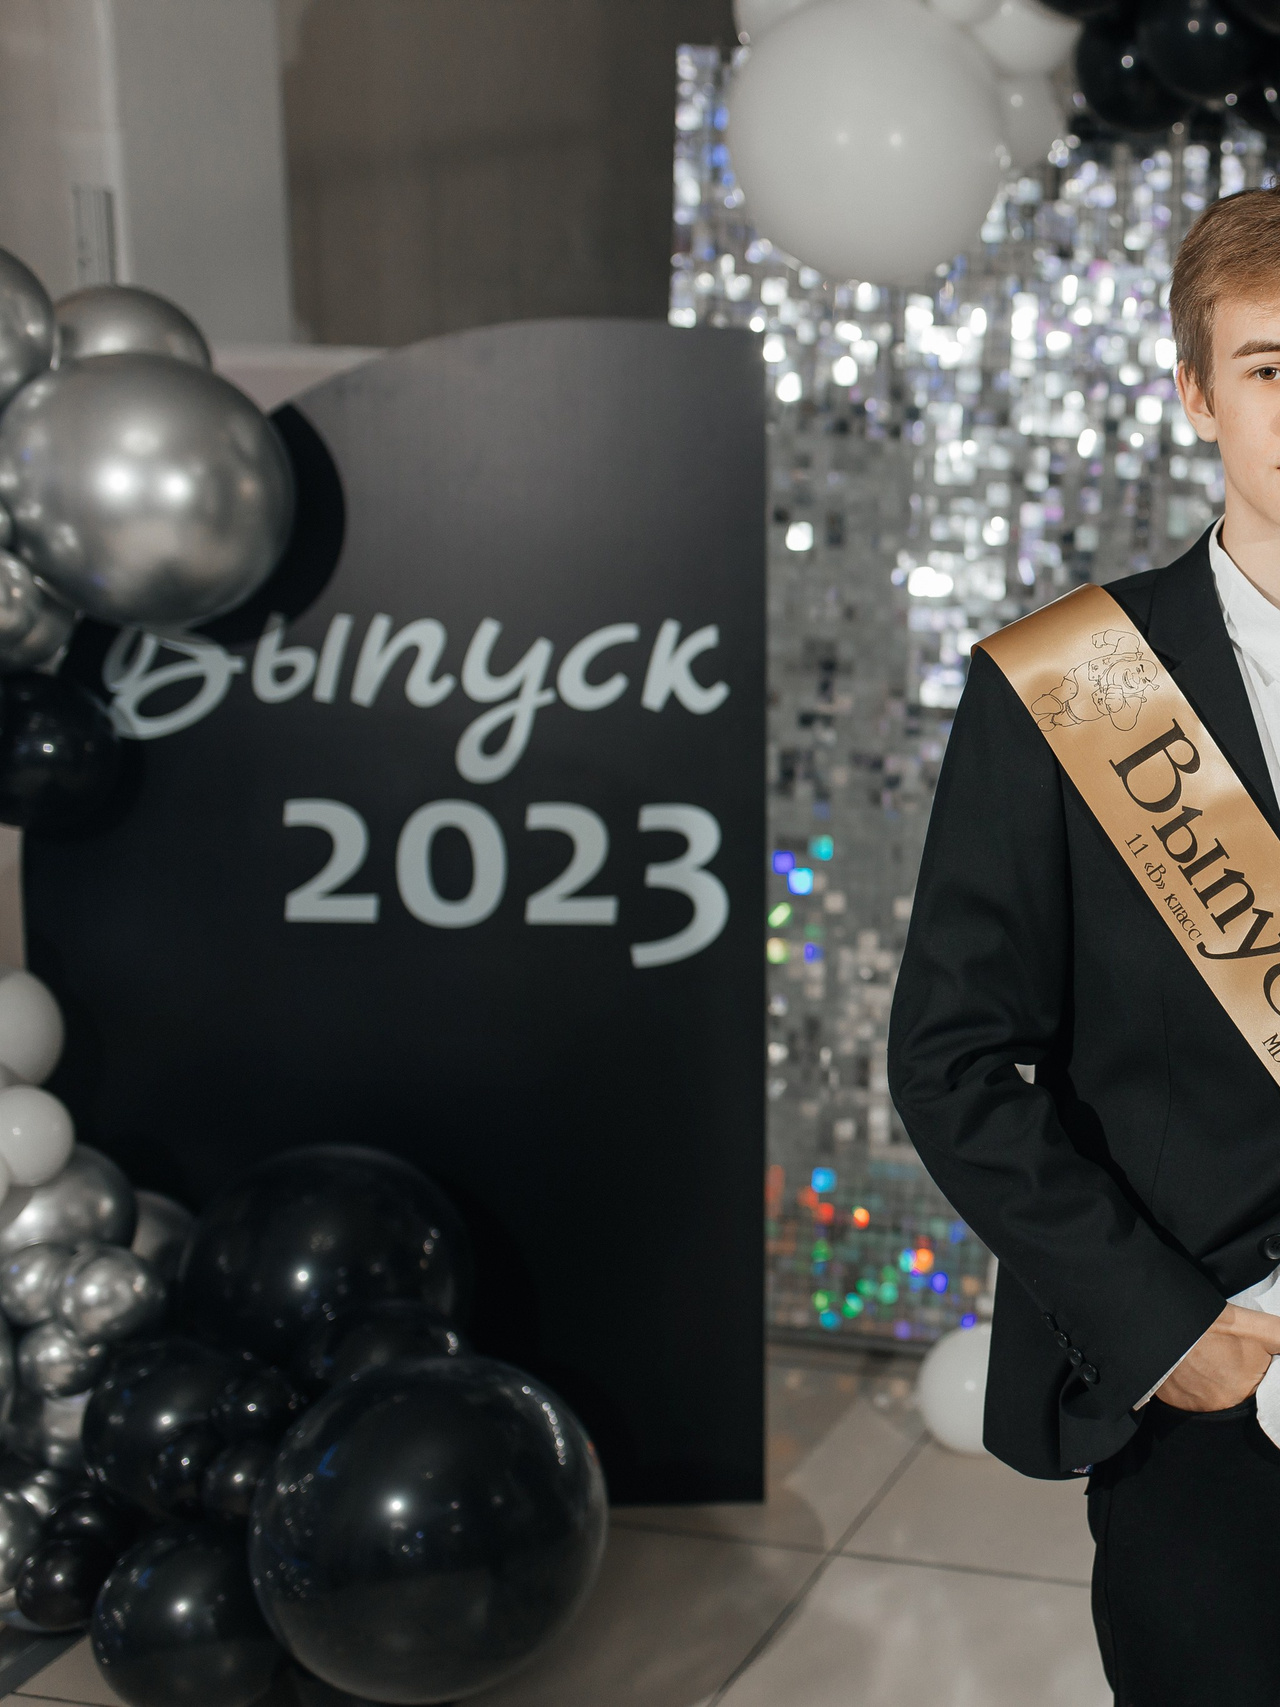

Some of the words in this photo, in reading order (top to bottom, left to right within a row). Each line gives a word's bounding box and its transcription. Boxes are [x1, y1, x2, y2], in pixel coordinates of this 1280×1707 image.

[102, 612, 730, 784] Выпуск
[283, 799, 730, 968] 2023
[1124, 833, 1149, 858] 11
[1164, 893, 1202, 941] класс
